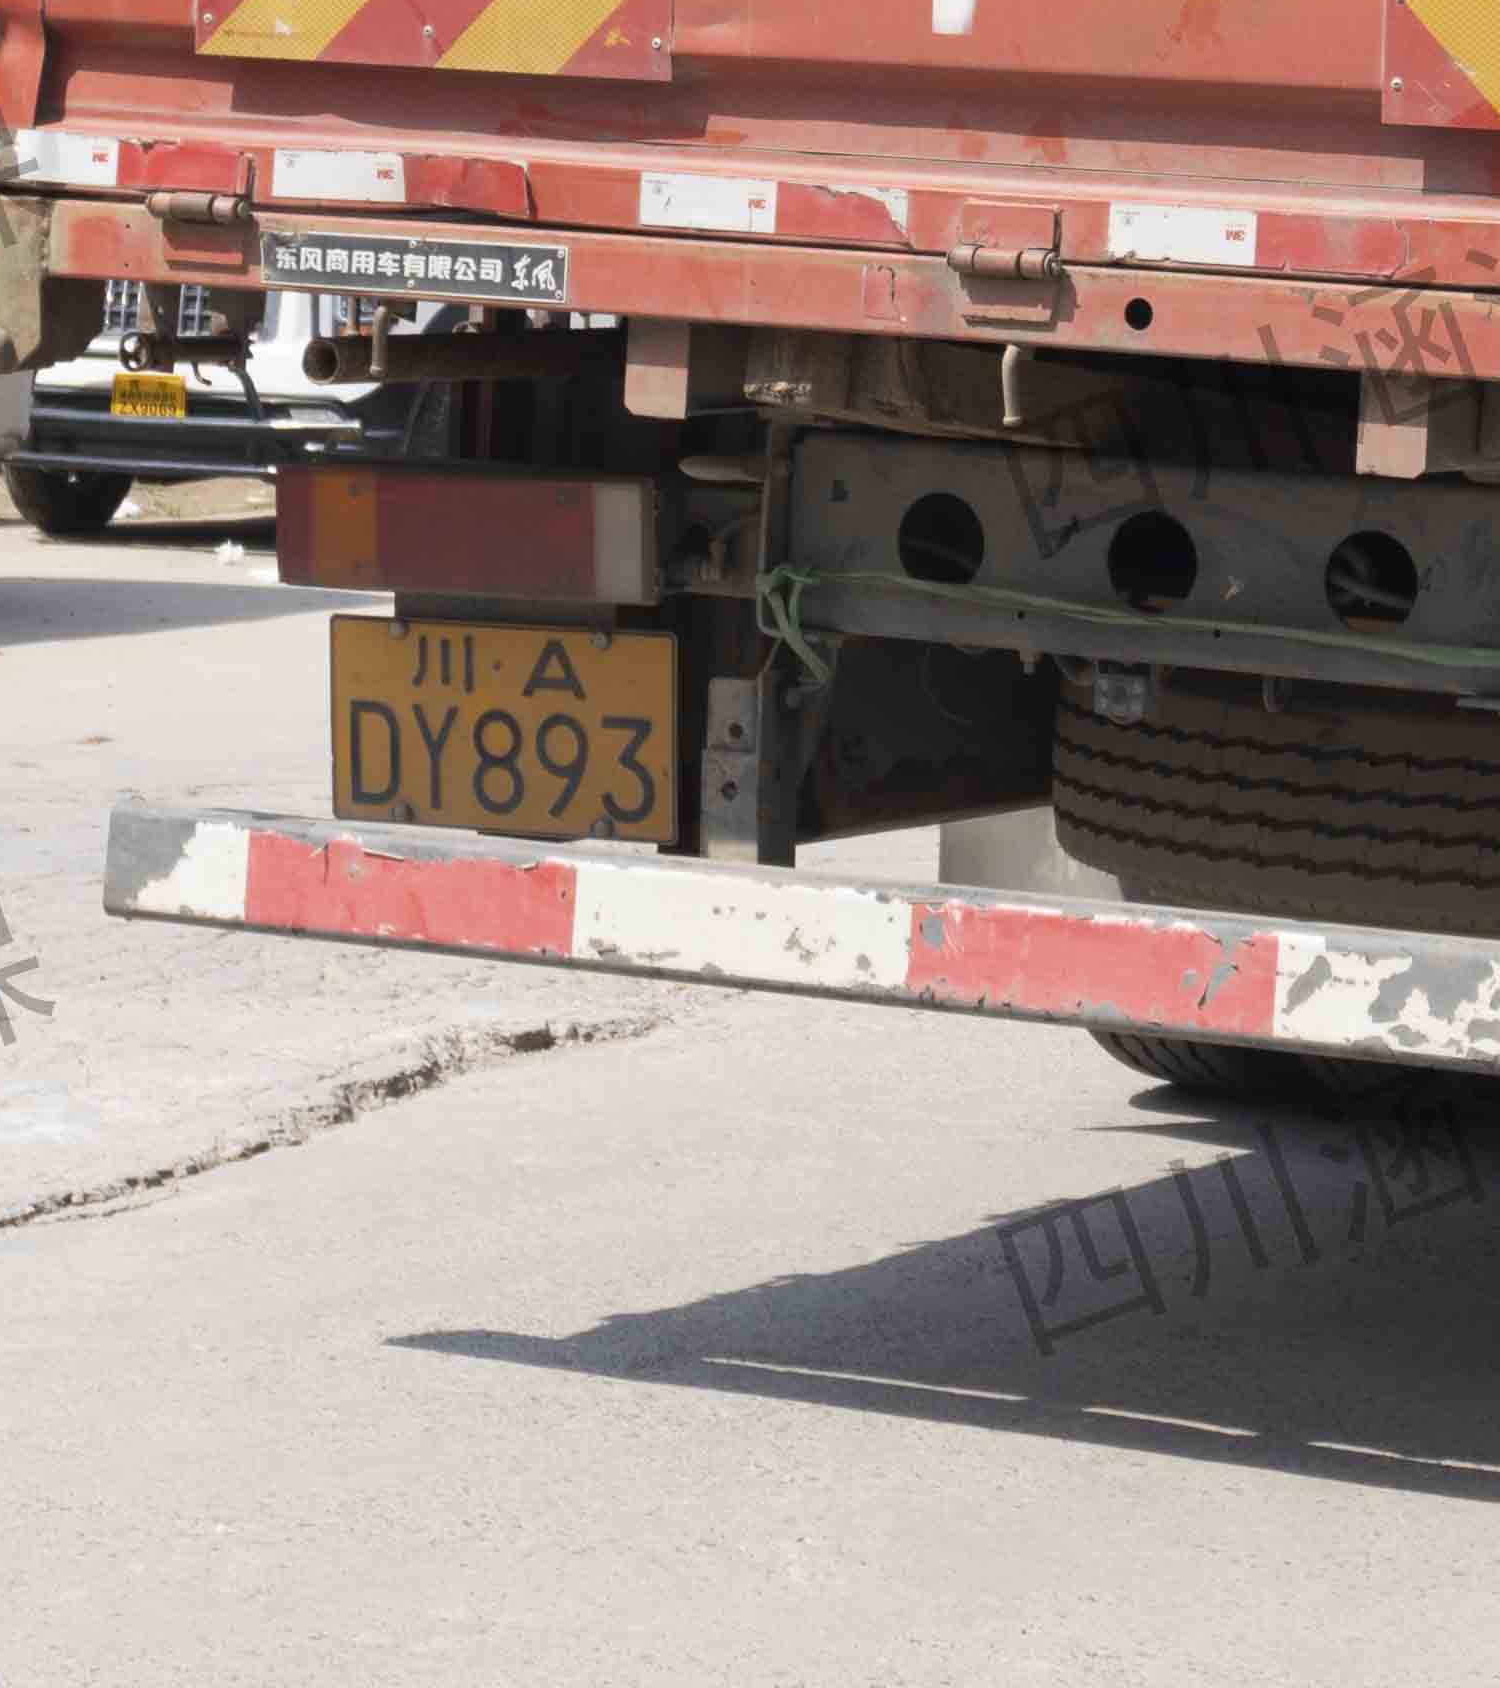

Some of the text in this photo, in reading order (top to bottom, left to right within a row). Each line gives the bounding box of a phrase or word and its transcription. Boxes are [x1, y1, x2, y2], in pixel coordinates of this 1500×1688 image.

[1225, 229, 1245, 241] 3M
[275, 246, 503, 283] 东风商用车有限公司
[412, 633, 587, 700] 川·A
[349, 698, 656, 823] DY893
